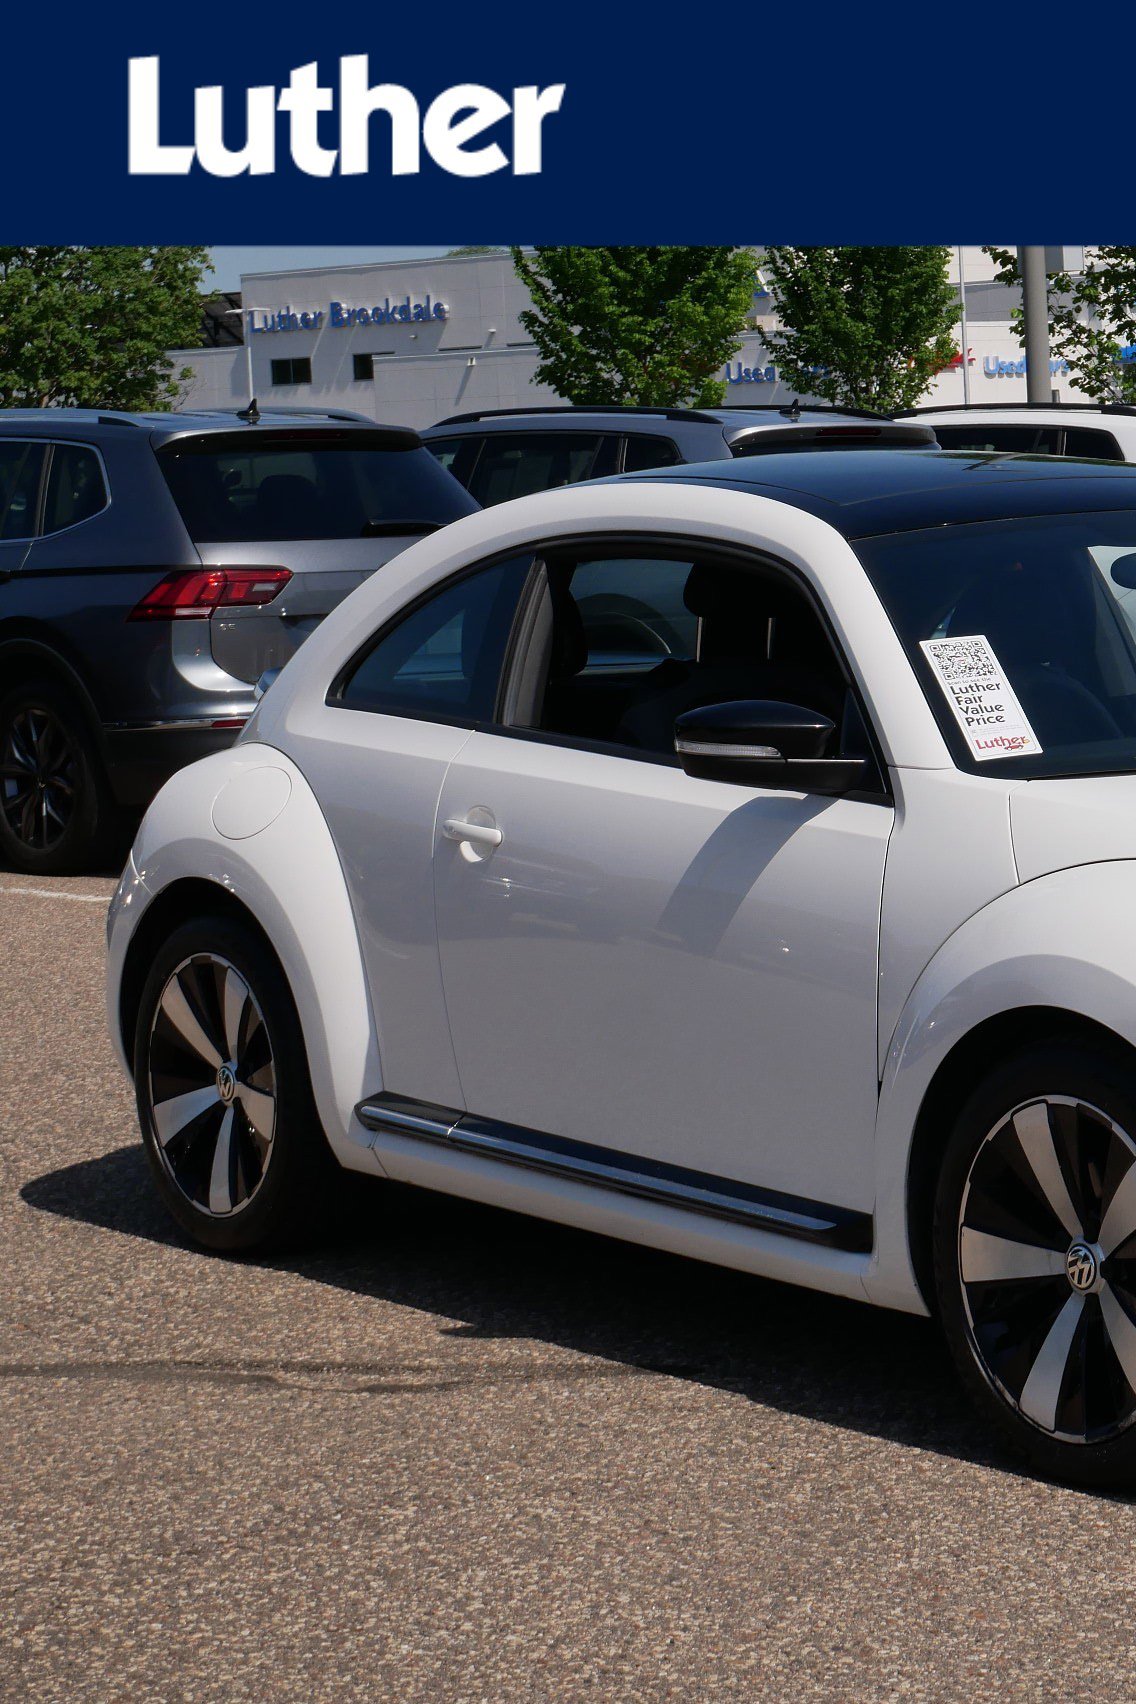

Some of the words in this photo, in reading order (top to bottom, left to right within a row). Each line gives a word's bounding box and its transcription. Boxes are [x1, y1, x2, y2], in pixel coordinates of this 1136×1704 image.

[251, 305, 325, 333] Luther
[330, 294, 449, 328] Brookdale
[950, 683, 1001, 695] Luther
[955, 693, 983, 705] Fair
[959, 704, 1005, 716] Value
[965, 714, 1006, 727] Price
[975, 735, 1026, 750] Luther
